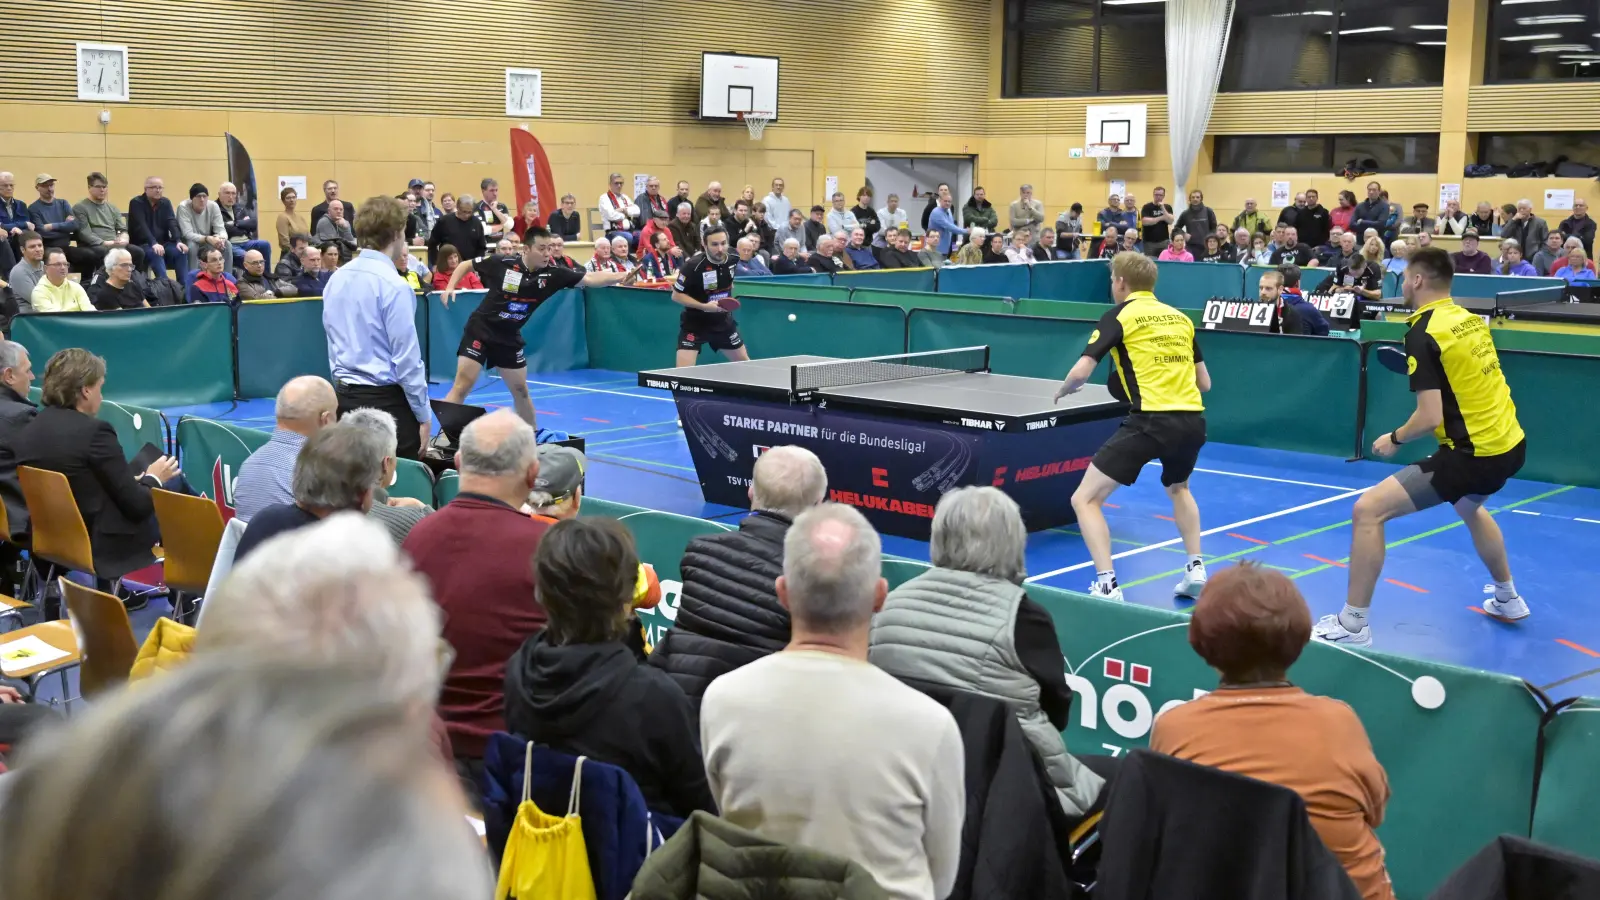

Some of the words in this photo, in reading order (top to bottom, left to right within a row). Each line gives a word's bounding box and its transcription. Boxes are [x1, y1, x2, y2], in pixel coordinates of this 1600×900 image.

[1335, 295, 1346, 308] 5
[1208, 304, 1220, 321] 0
[1229, 305, 1236, 317] 1
[1240, 305, 1249, 317] 2
[1255, 306, 1266, 324] 4
[1154, 355, 1190, 363] FLEMMIN
[646, 379, 669, 389] TIBHAR
[961, 418, 992, 430] TIBHAR
[1026, 419, 1048, 431] TIBHAR
[723, 415, 765, 431] STARKE
[767, 420, 818, 438] PARTNER
[821, 427, 836, 441] für
[840, 431, 856, 444] die
[859, 433, 926, 455] Bundesliga!
[1015, 456, 1092, 482] HELUKABE
[727, 475, 742, 486] TSV
[744, 478, 753, 488] 18
